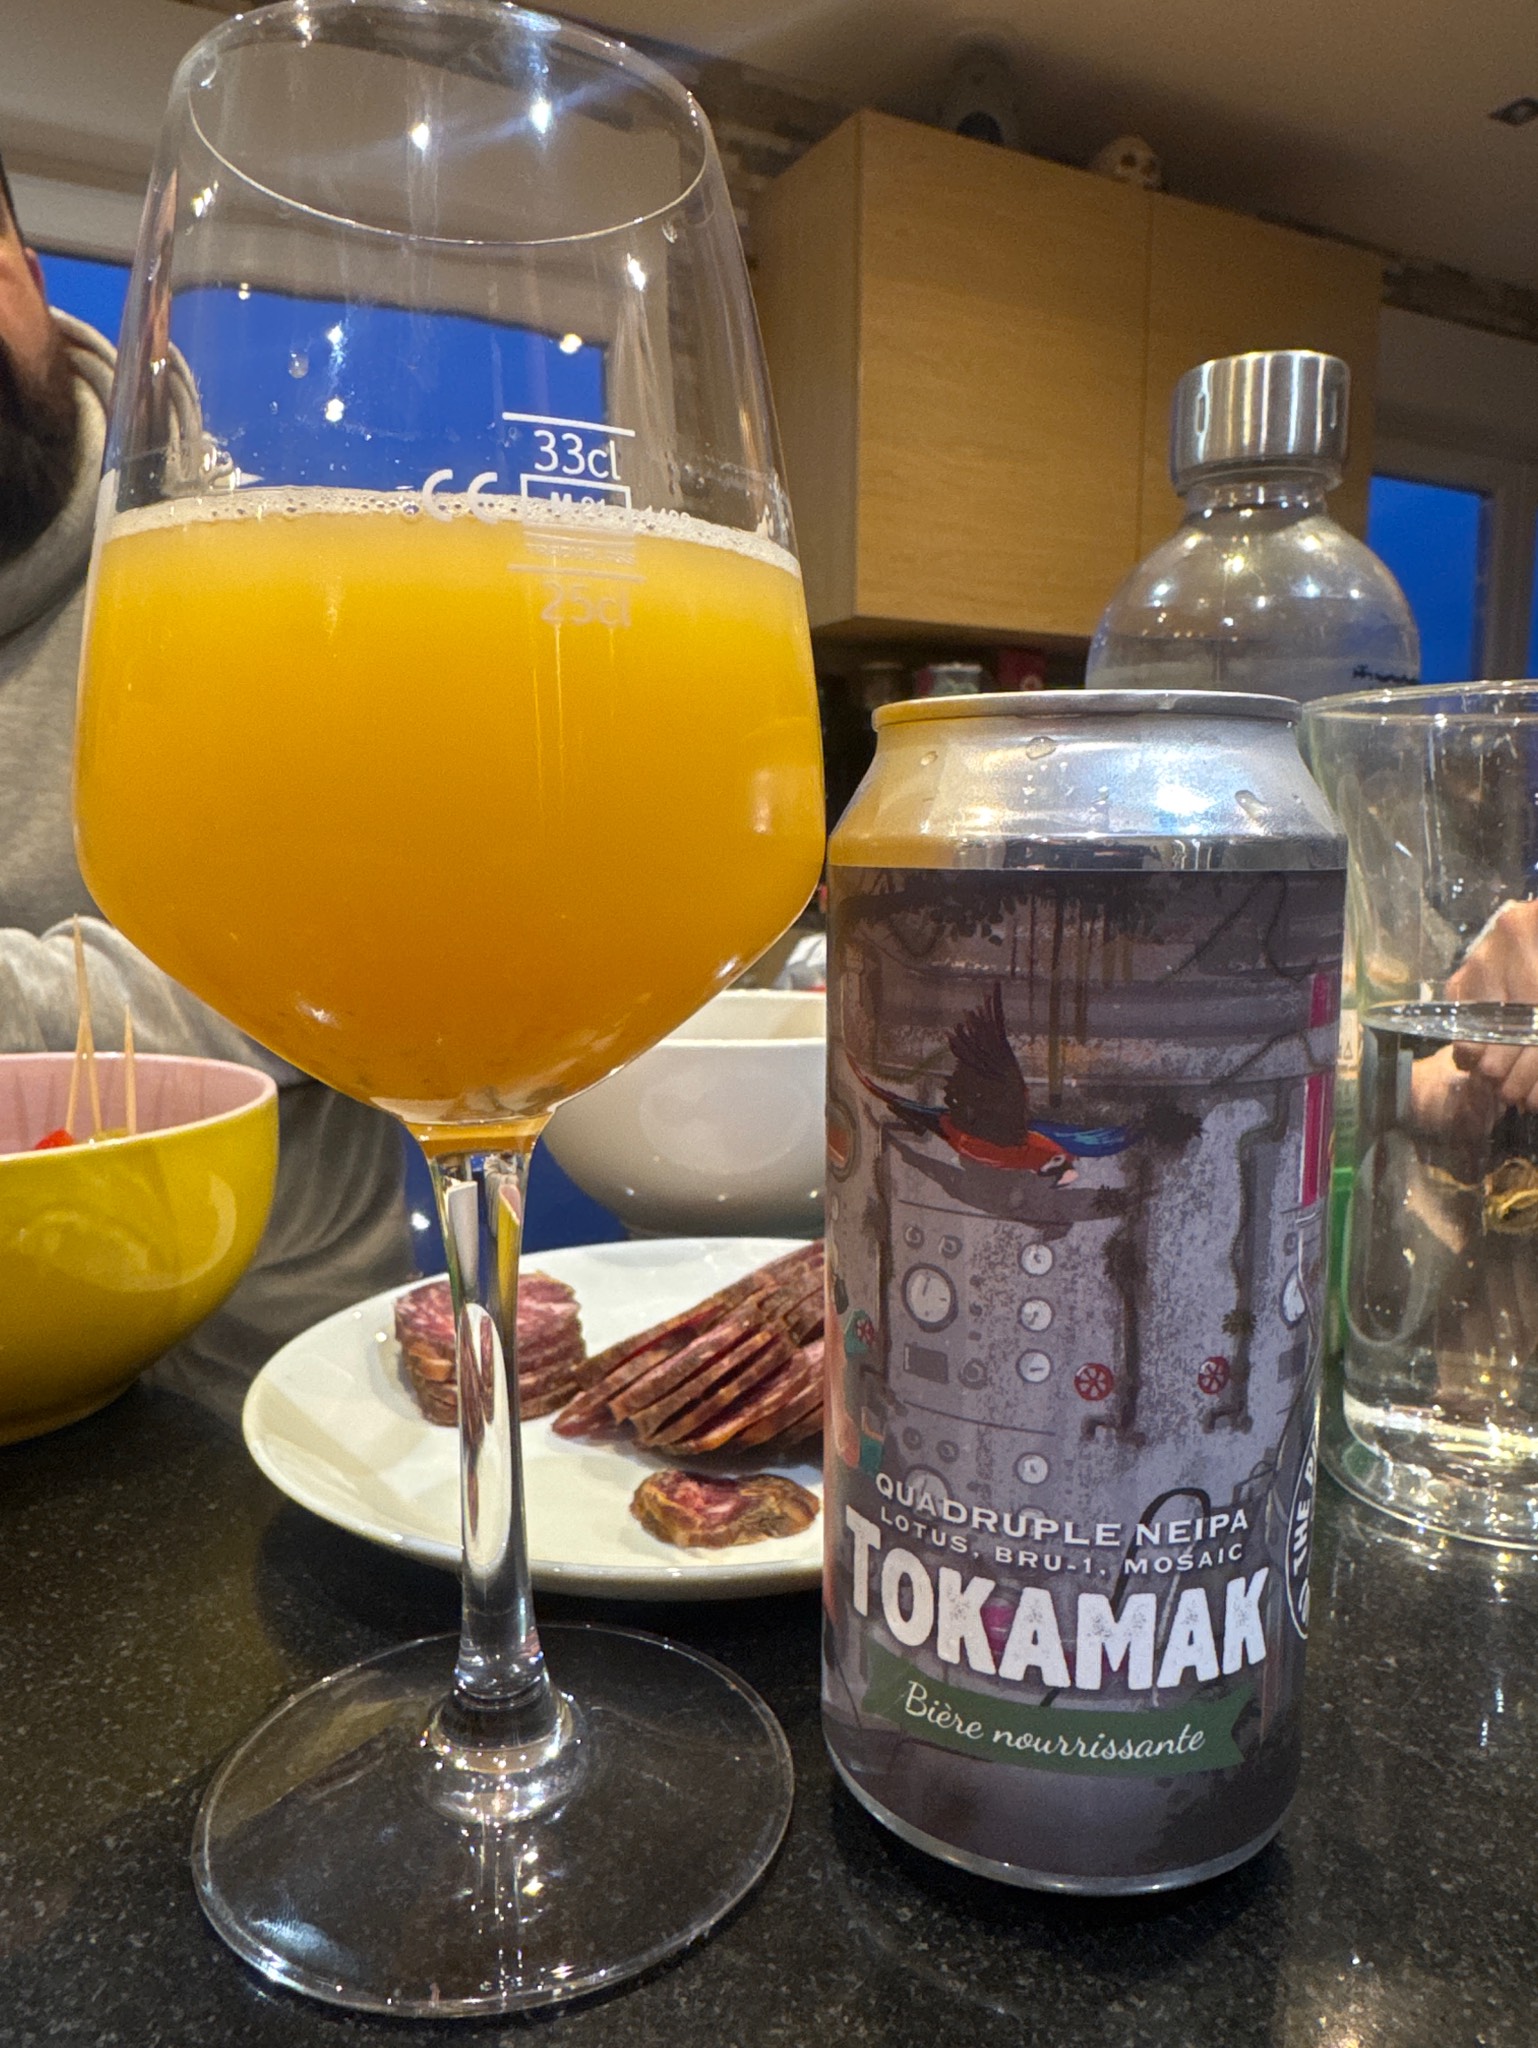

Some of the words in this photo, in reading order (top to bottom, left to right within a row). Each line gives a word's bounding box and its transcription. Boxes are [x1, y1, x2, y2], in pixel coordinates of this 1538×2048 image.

[533, 429, 621, 481] 33cl
[540, 580, 632, 629] 25cl
[876, 1472, 1122, 1547] QUADRUPLE
[1136, 1508, 1249, 1547] NEIPA
[881, 1506, 980, 1560] LOTUS,
[995, 1546, 1107, 1577] BRU-1,
[1124, 1543, 1243, 1576] MOSAIC
[1293, 1498, 1310, 1577] THE
[845, 1506, 1270, 1691] TOKAMAK
[904, 1679, 984, 1740] Bière
[992, 1723, 1206, 1760] nourrissante
